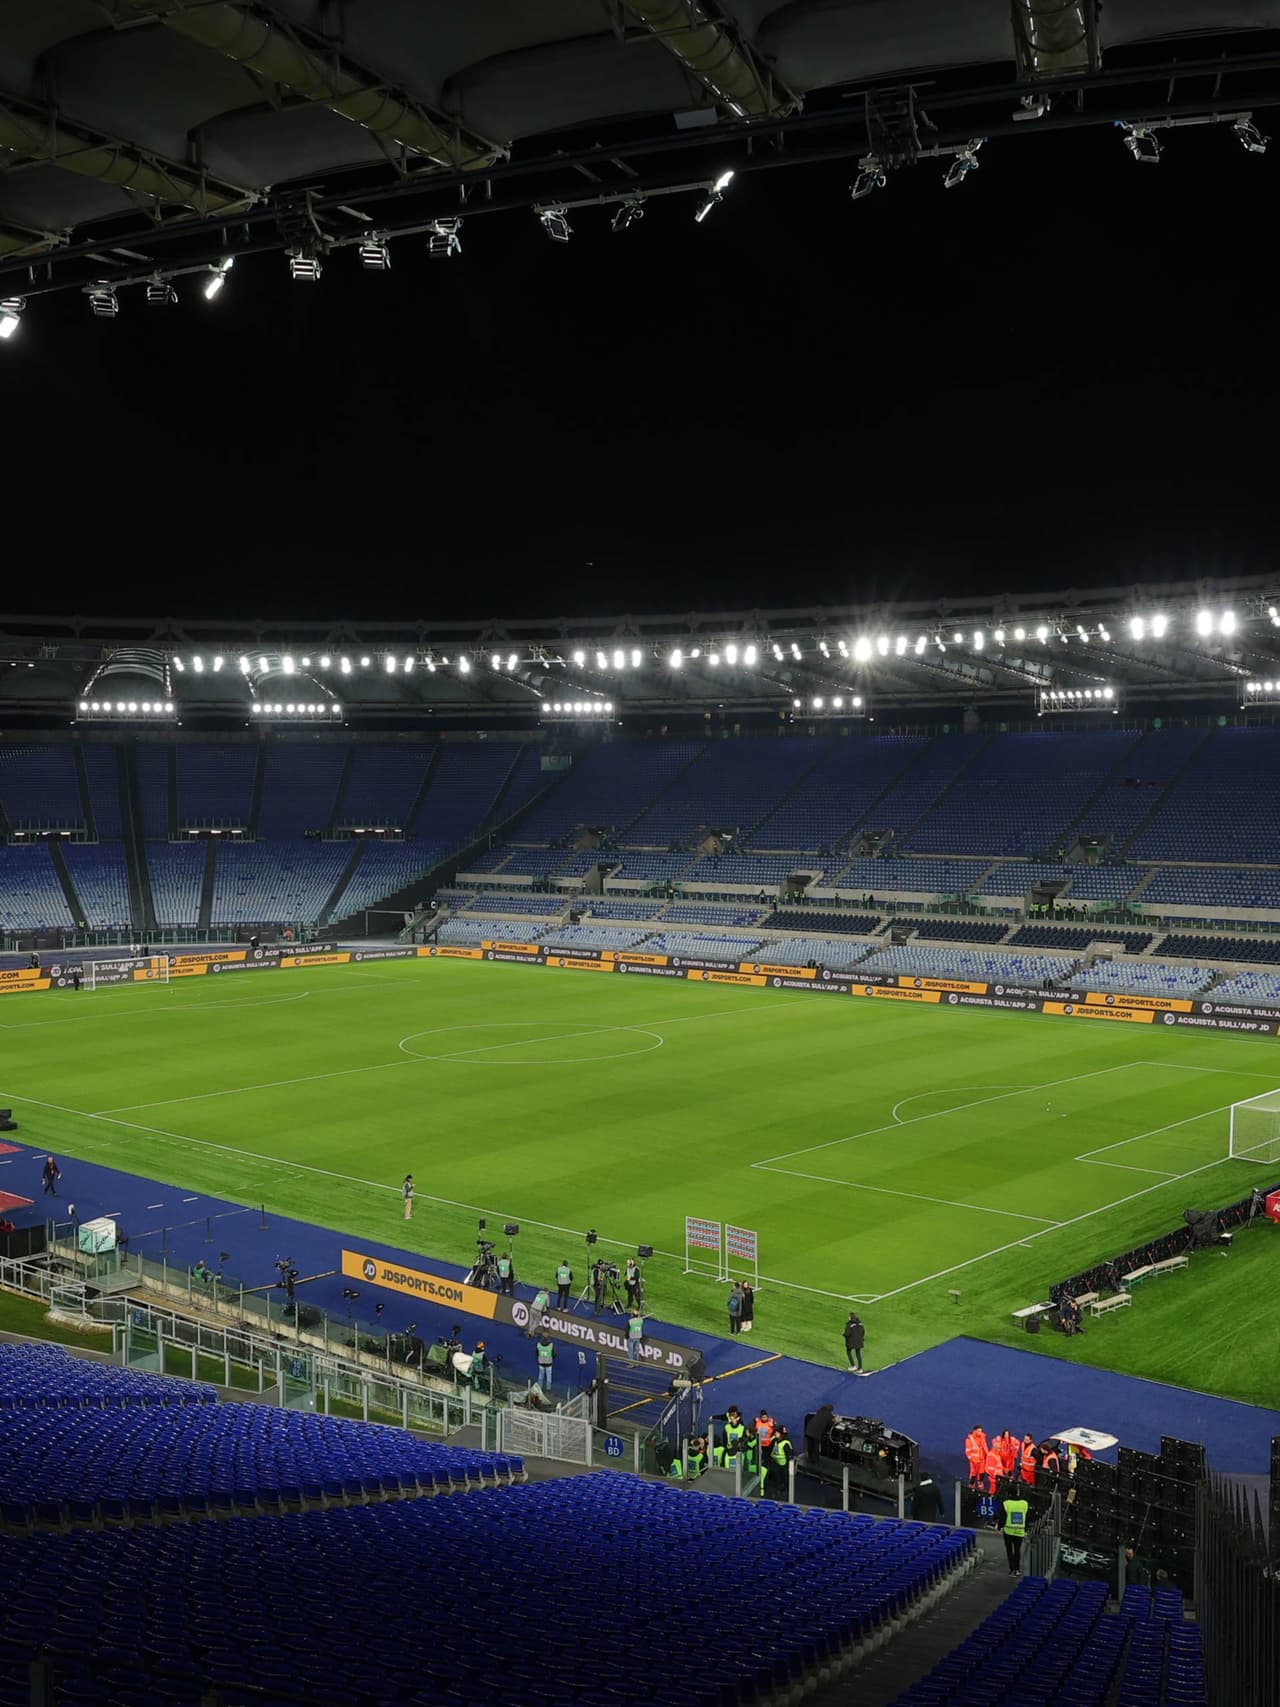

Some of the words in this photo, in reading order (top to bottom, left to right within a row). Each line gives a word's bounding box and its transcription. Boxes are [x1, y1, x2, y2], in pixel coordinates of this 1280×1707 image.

[782, 980, 810, 989] ACQUISTA
[812, 982, 838, 992] SULL'APP
[924, 980, 970, 990] JDSPORTS.COM
[876, 988, 922, 999] JDSPORTS.COM
[1038, 991, 1070, 1000] SULL'APP
[960, 996, 993, 1006] ACQUISTA
[994, 999, 1026, 1008] SULL'APP
[1118, 998, 1172, 1008] JDSPORTS.COM
[1076, 1007, 1132, 1018] JDSPORTS.COM
[1214, 1006, 1252, 1016] ACQUISTA
[1178, 1016, 1218, 1027] ACQUISTA
[1218, 1021, 1258, 1031] SULL'APP
[364, 1264, 374, 1276] JD
[381, 1269, 464, 1302] JDSPORTS.COM
[540, 1315, 596, 1343] CQUISTA
[598, 1332, 662, 1361] SULLAPP
[665, 1351, 684, 1367] JD
[609, 1438, 618, 1448] 11
[608, 1446, 620, 1456] BD
[982, 1496, 993, 1506] 11
[980, 1506, 994, 1516] BS
